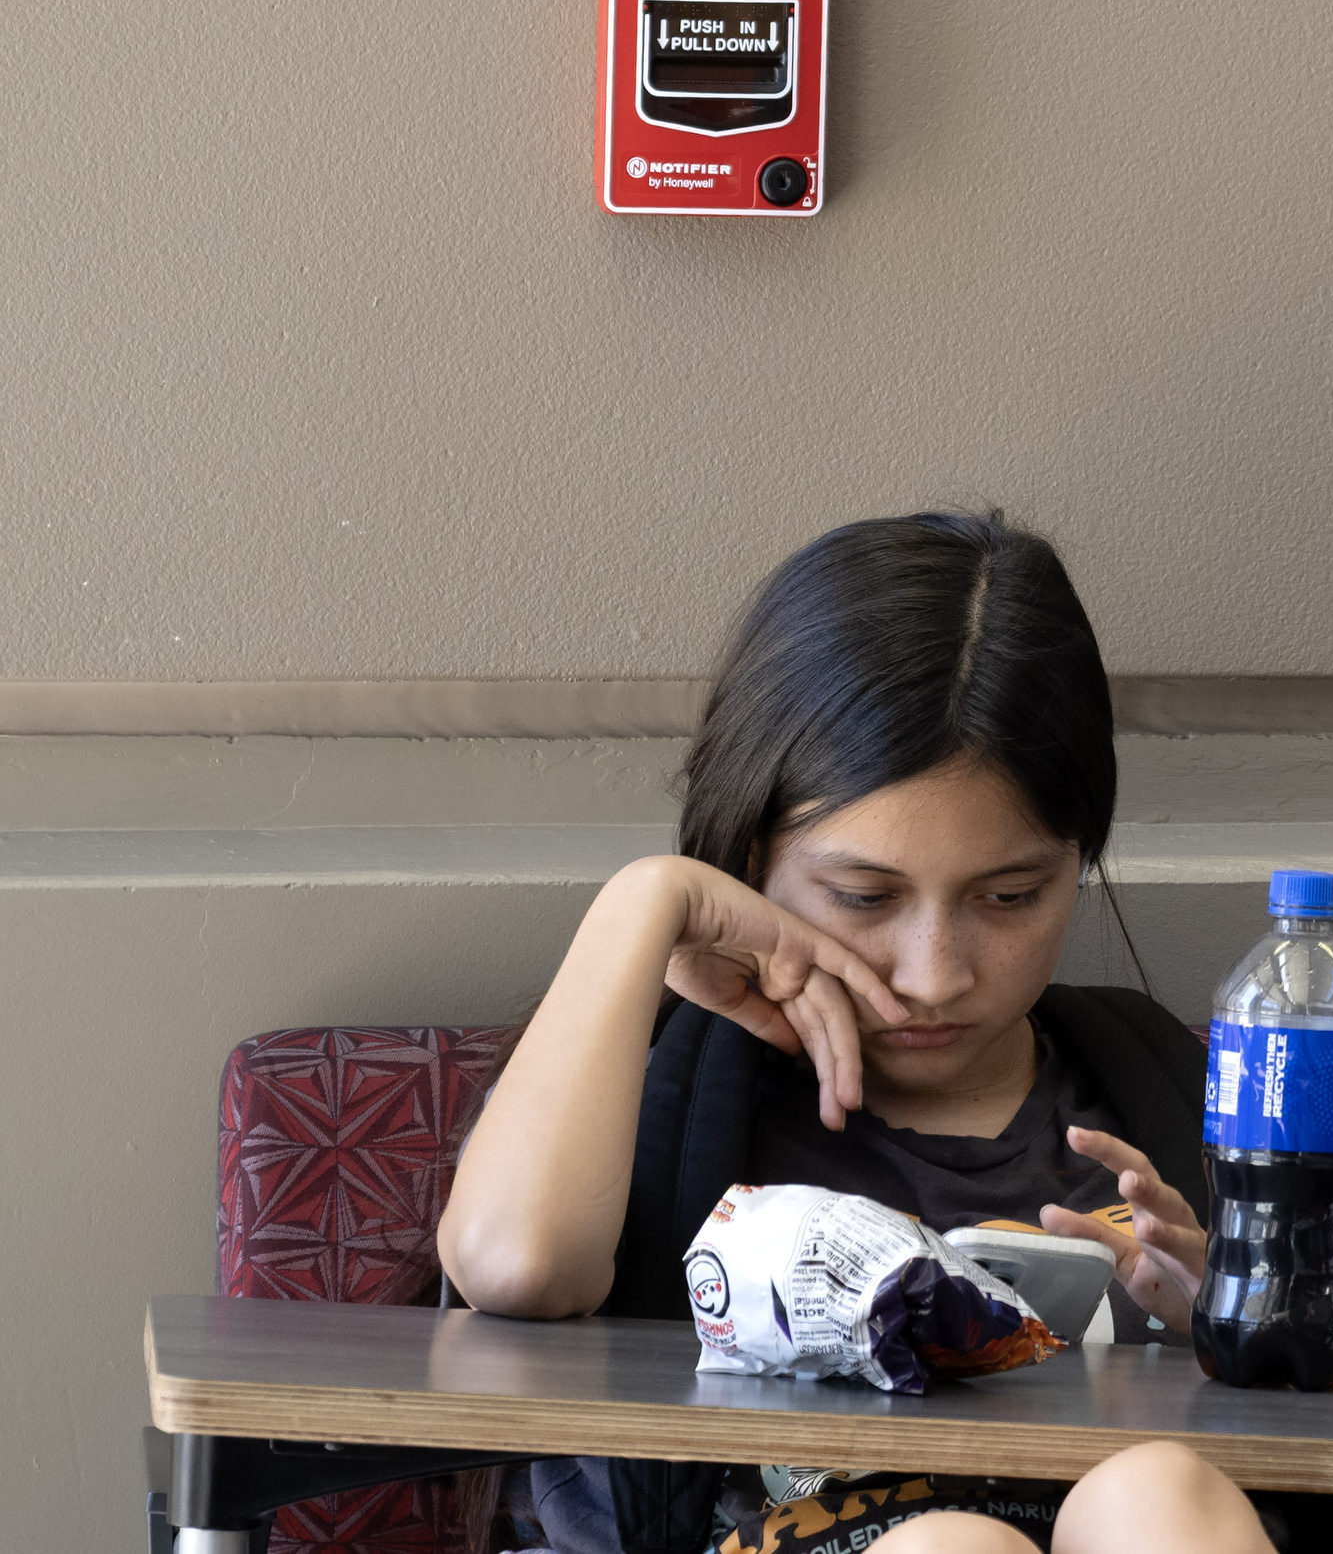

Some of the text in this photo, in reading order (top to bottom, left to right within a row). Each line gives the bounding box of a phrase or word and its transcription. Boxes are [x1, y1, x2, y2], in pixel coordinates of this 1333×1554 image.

[680, 19, 755, 34] PUSH IN
[671, 38, 767, 52] PULL DOWN
[650, 162, 731, 175] NOTIFIER
[649, 177, 714, 190] by Honeywell
[1262, 1033, 1277, 1118] REFRESH THEN
[1272, 1034, 1287, 1118] RECYCLE
[804, 1523, 884, 1554] OILED
